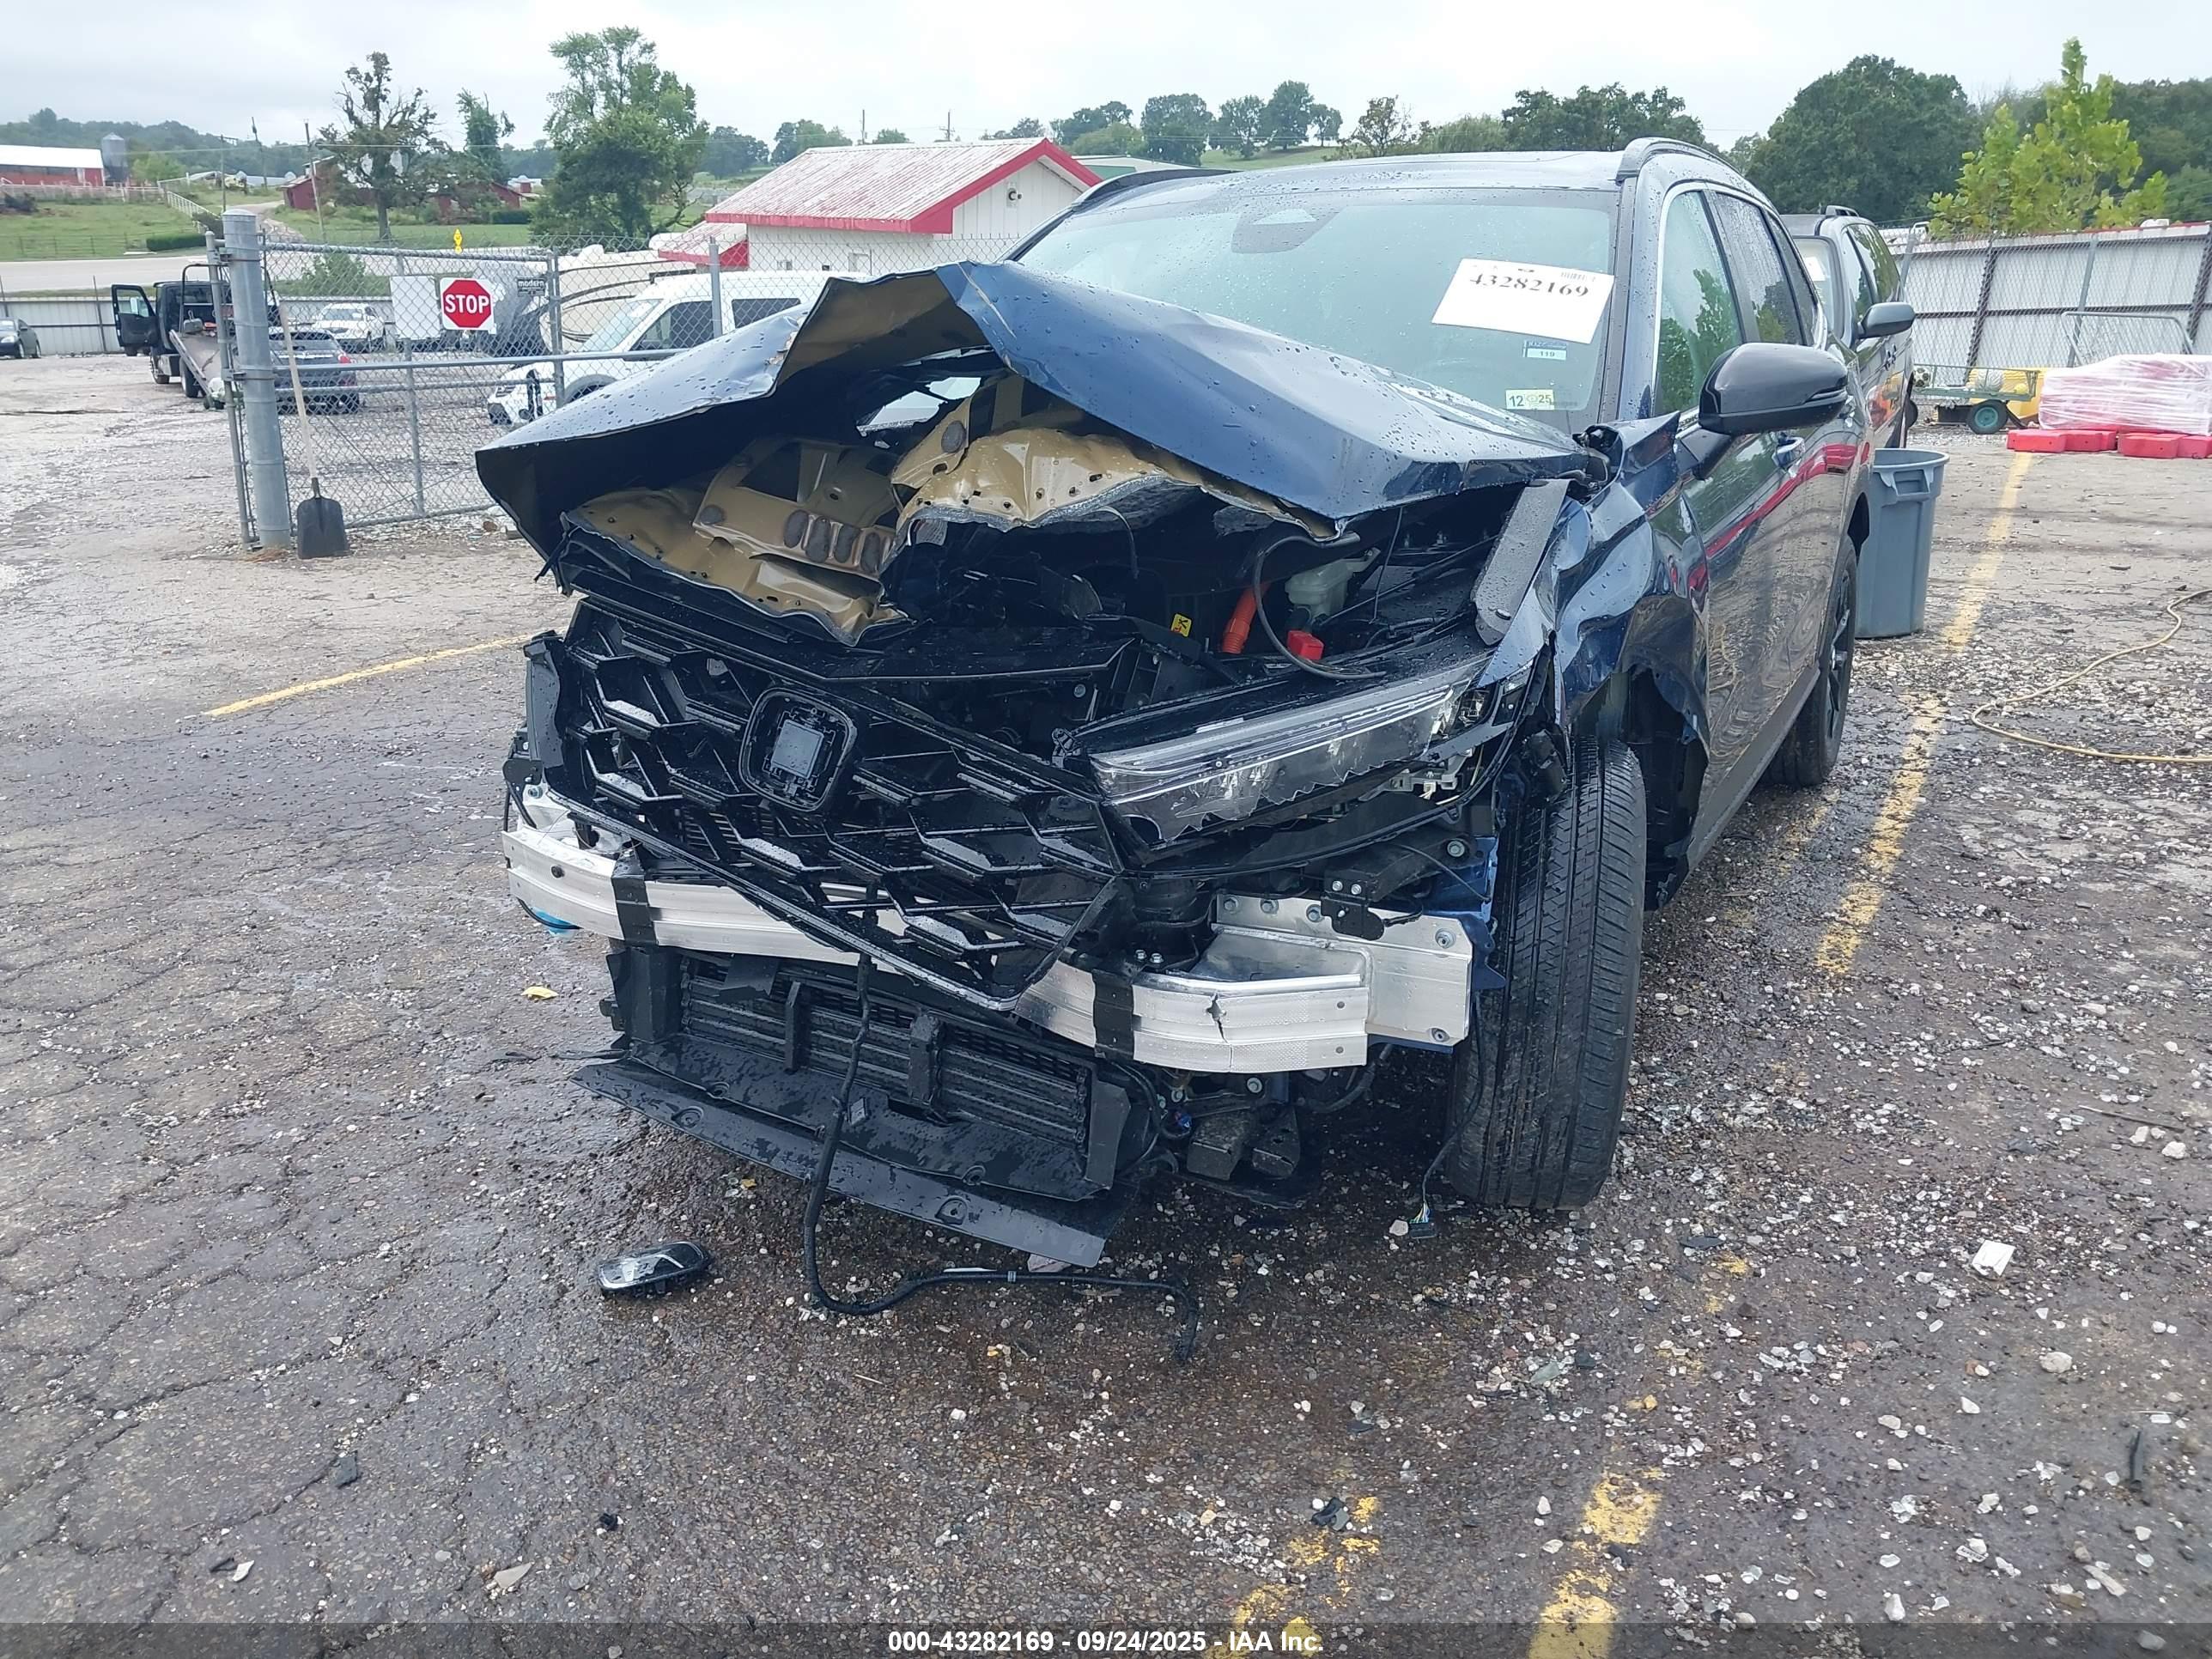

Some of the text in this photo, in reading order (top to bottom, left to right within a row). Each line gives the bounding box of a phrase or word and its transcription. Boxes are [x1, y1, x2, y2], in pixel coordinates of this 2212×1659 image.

[1469, 273, 1589, 297] 43282169
[445, 294, 489, 313] STOP
[1509, 395, 1524, 407] 12
